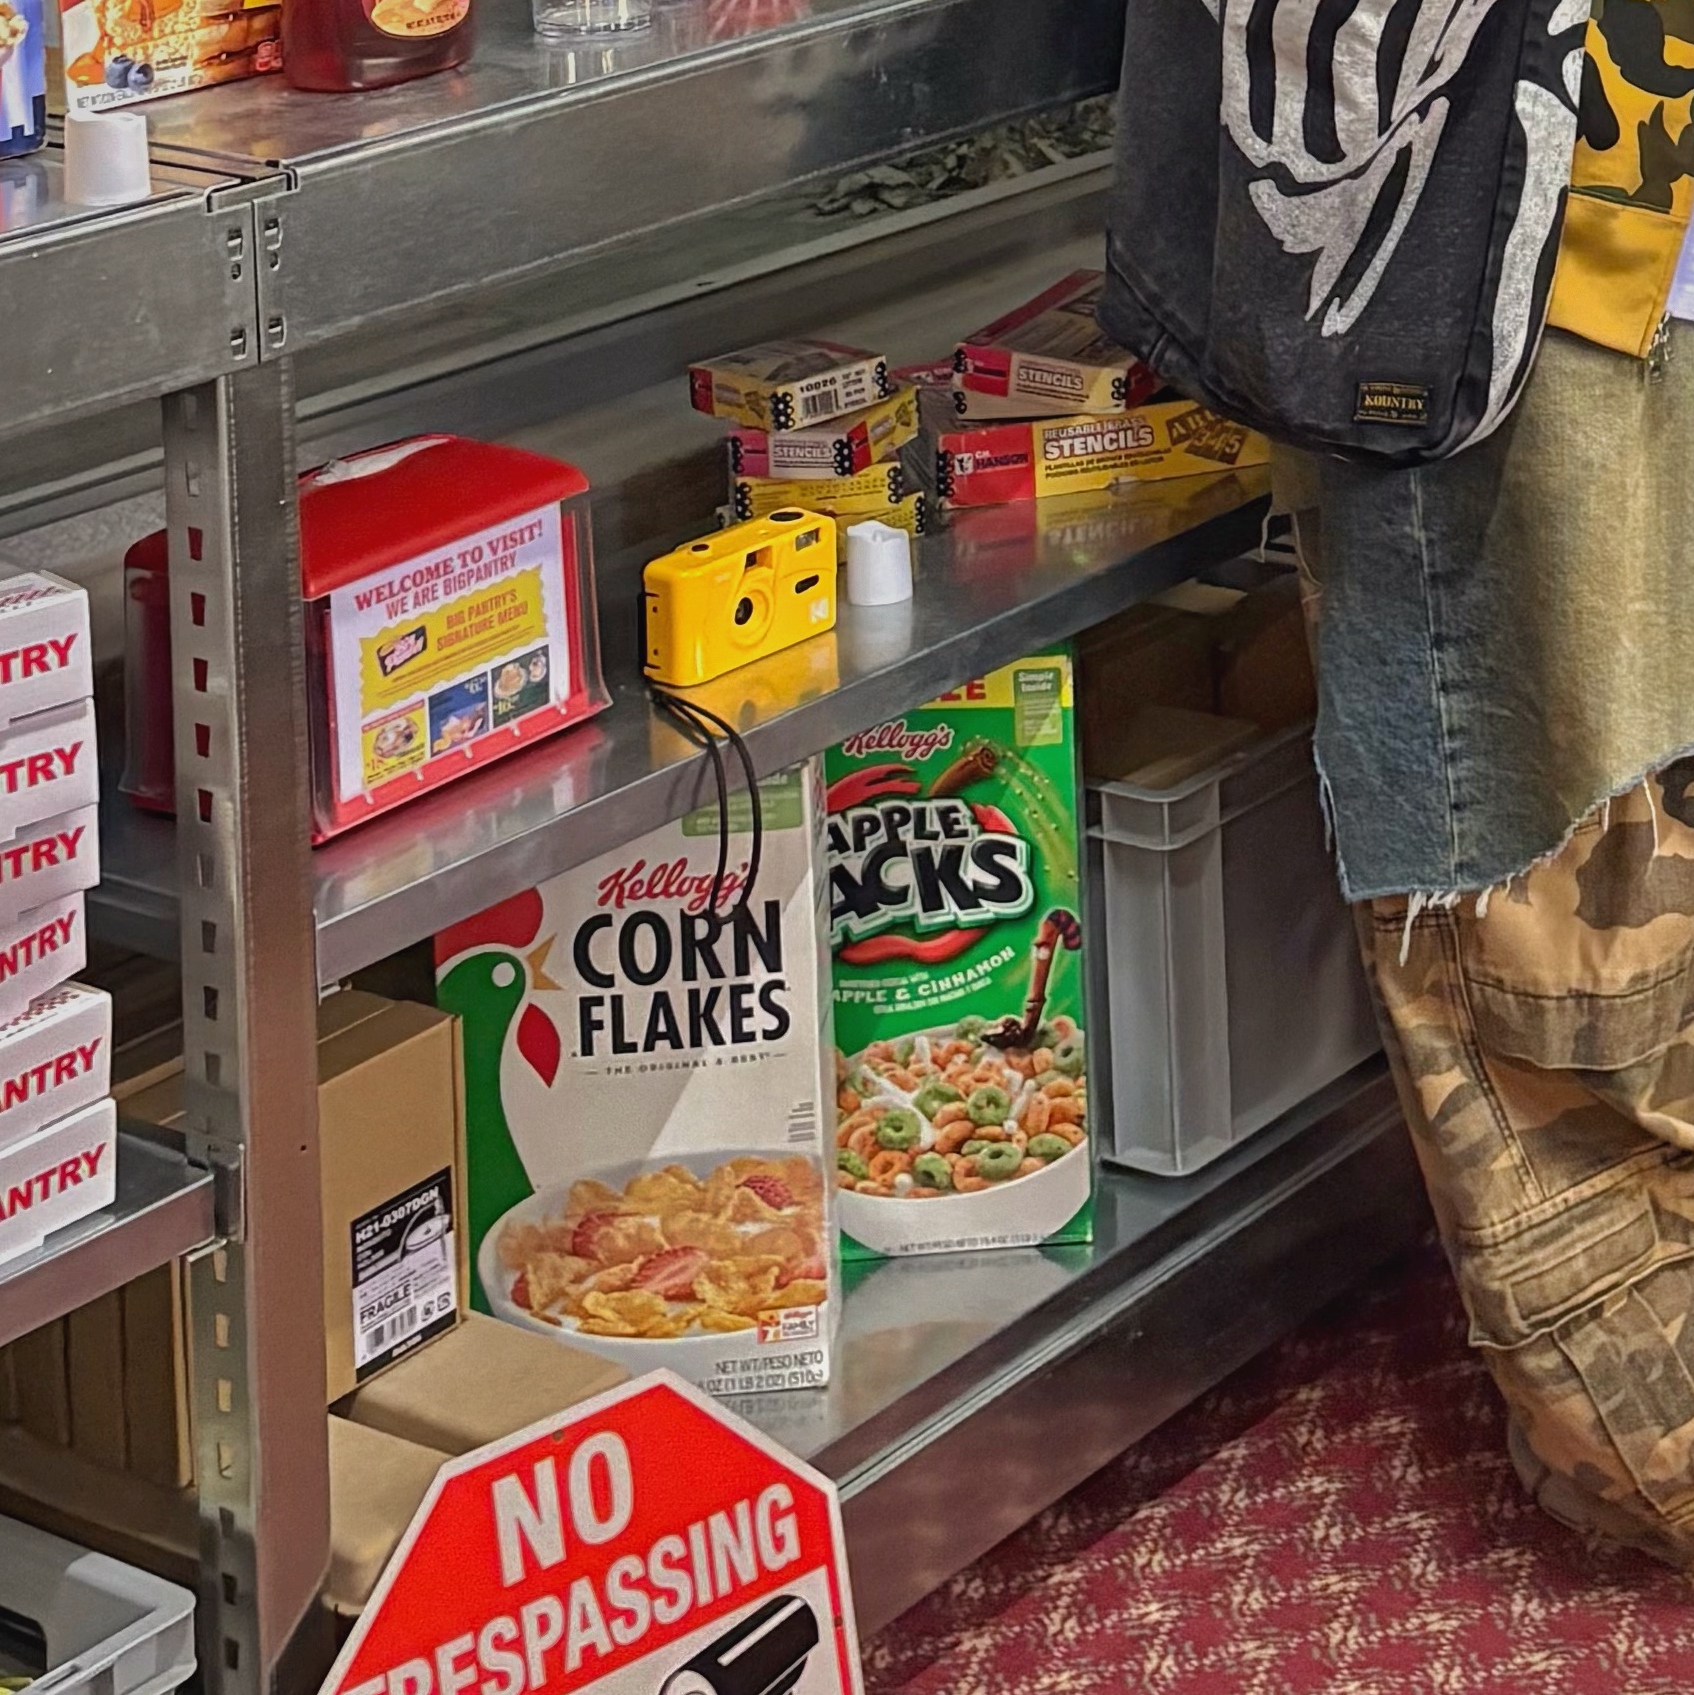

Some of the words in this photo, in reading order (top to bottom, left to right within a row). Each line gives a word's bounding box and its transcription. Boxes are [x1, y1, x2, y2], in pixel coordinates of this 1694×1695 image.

[800, 375, 838, 394] 10026
[1018, 367, 1084, 390] STENCILS
[773, 445, 833, 459] STENCILS
[1044, 426, 1155, 461] STENCILS
[354, 556, 455, 612] WELCOME
[457, 545, 484, 569] TO
[487, 519, 544, 556] VISIT!
[385, 599, 410, 621] WE
[412, 582, 440, 609] ARE
[443, 551, 518, 598] BIGPANTRY
[0, 632, 79, 685] TRY
[0, 740, 84, 794] TRY
[845, 722, 955, 758] Kellogg's
[827, 804, 972, 854] APPLE
[597, 857, 751, 911] Kellogg'
[830, 838, 1025, 921] ACKS
[0, 908, 77, 984] NTRY
[573, 899, 785, 989] CORN
[895, 987, 911, 1001] &
[917, 945, 1016, 996] CINNAMON
[577, 979, 792, 1058] FLAKES
[0, 1037, 103, 1116] NTRY
[605, 1064, 632, 1076] THE
[638, 1058, 709, 1074] ORIGINAL
[359, 1282, 412, 1324] FRAGILE
[491, 1429, 635, 1590] NO
